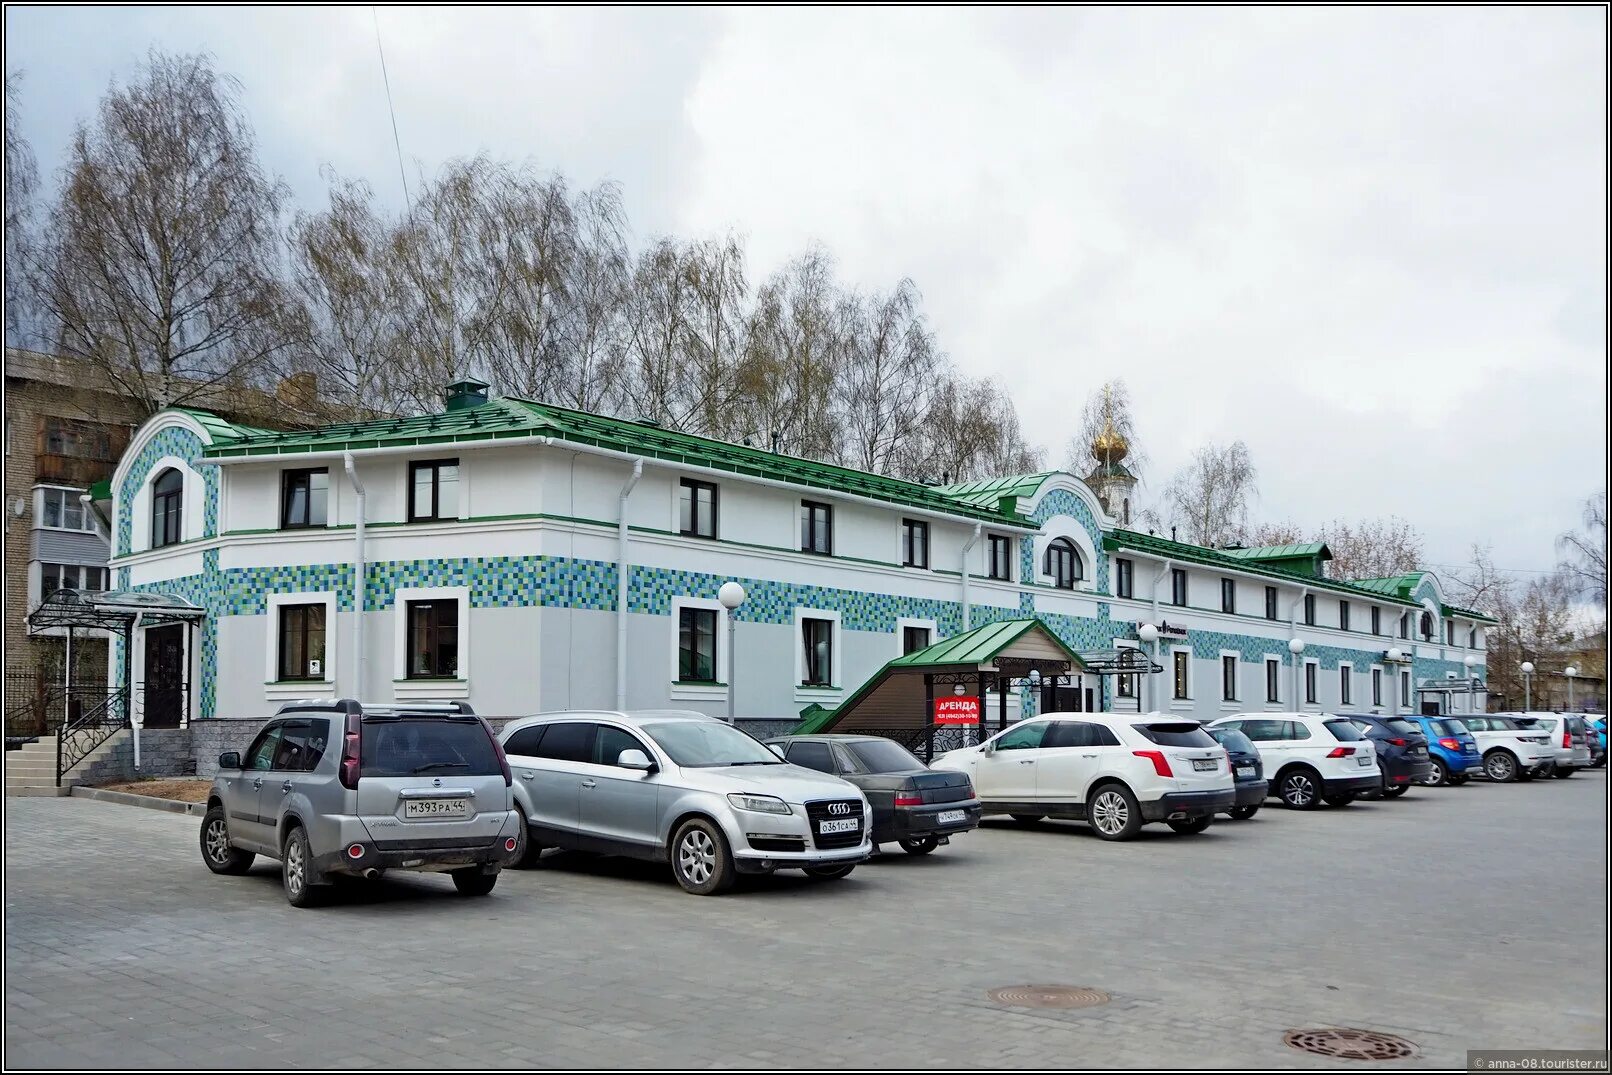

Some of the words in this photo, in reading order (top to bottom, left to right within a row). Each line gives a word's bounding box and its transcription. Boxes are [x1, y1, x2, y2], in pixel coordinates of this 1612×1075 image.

[939, 701, 977, 711] АРЕНДА
[410, 802, 451, 813] М393РА
[452, 801, 464, 810] 44
[822, 822, 849, 832] О361СА
